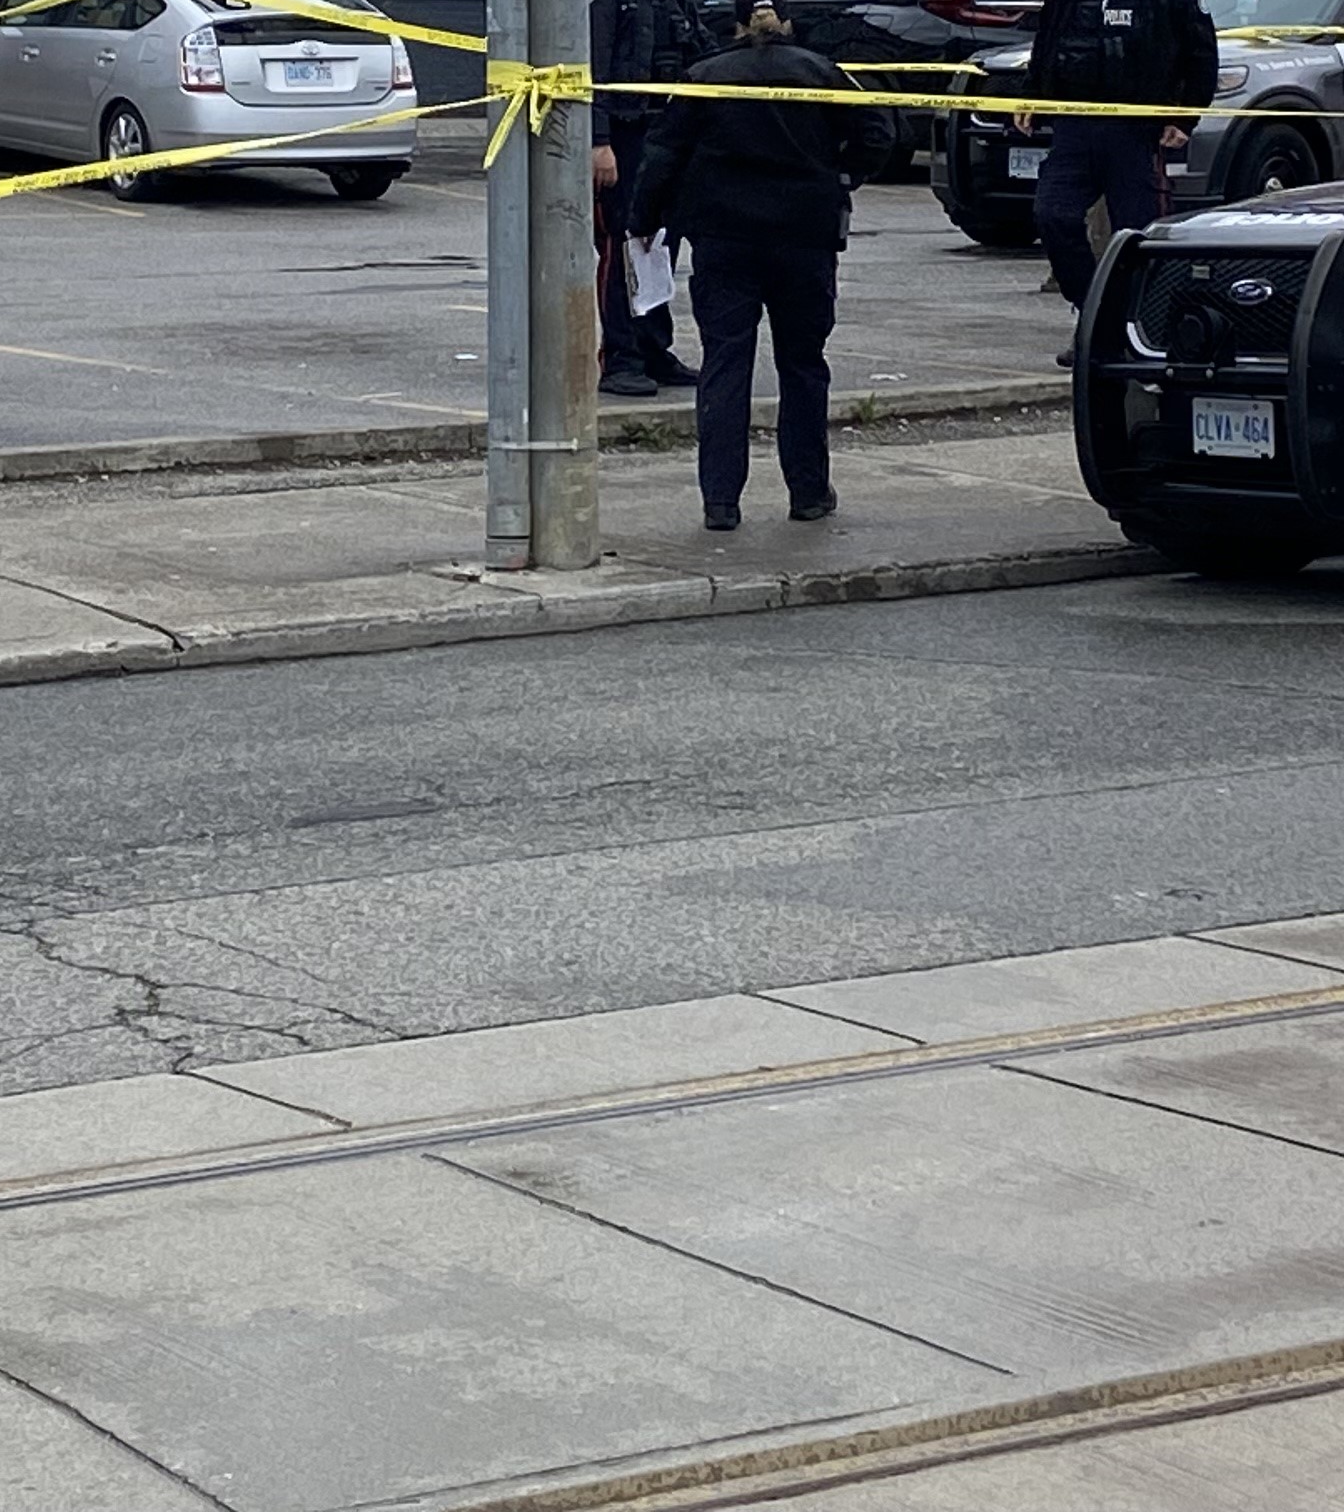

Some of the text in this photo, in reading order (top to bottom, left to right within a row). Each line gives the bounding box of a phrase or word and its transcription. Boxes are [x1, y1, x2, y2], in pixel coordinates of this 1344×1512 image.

[1103, 8, 1133, 27] POLICE
[1196, 412, 1270, 444] CLVA 464
